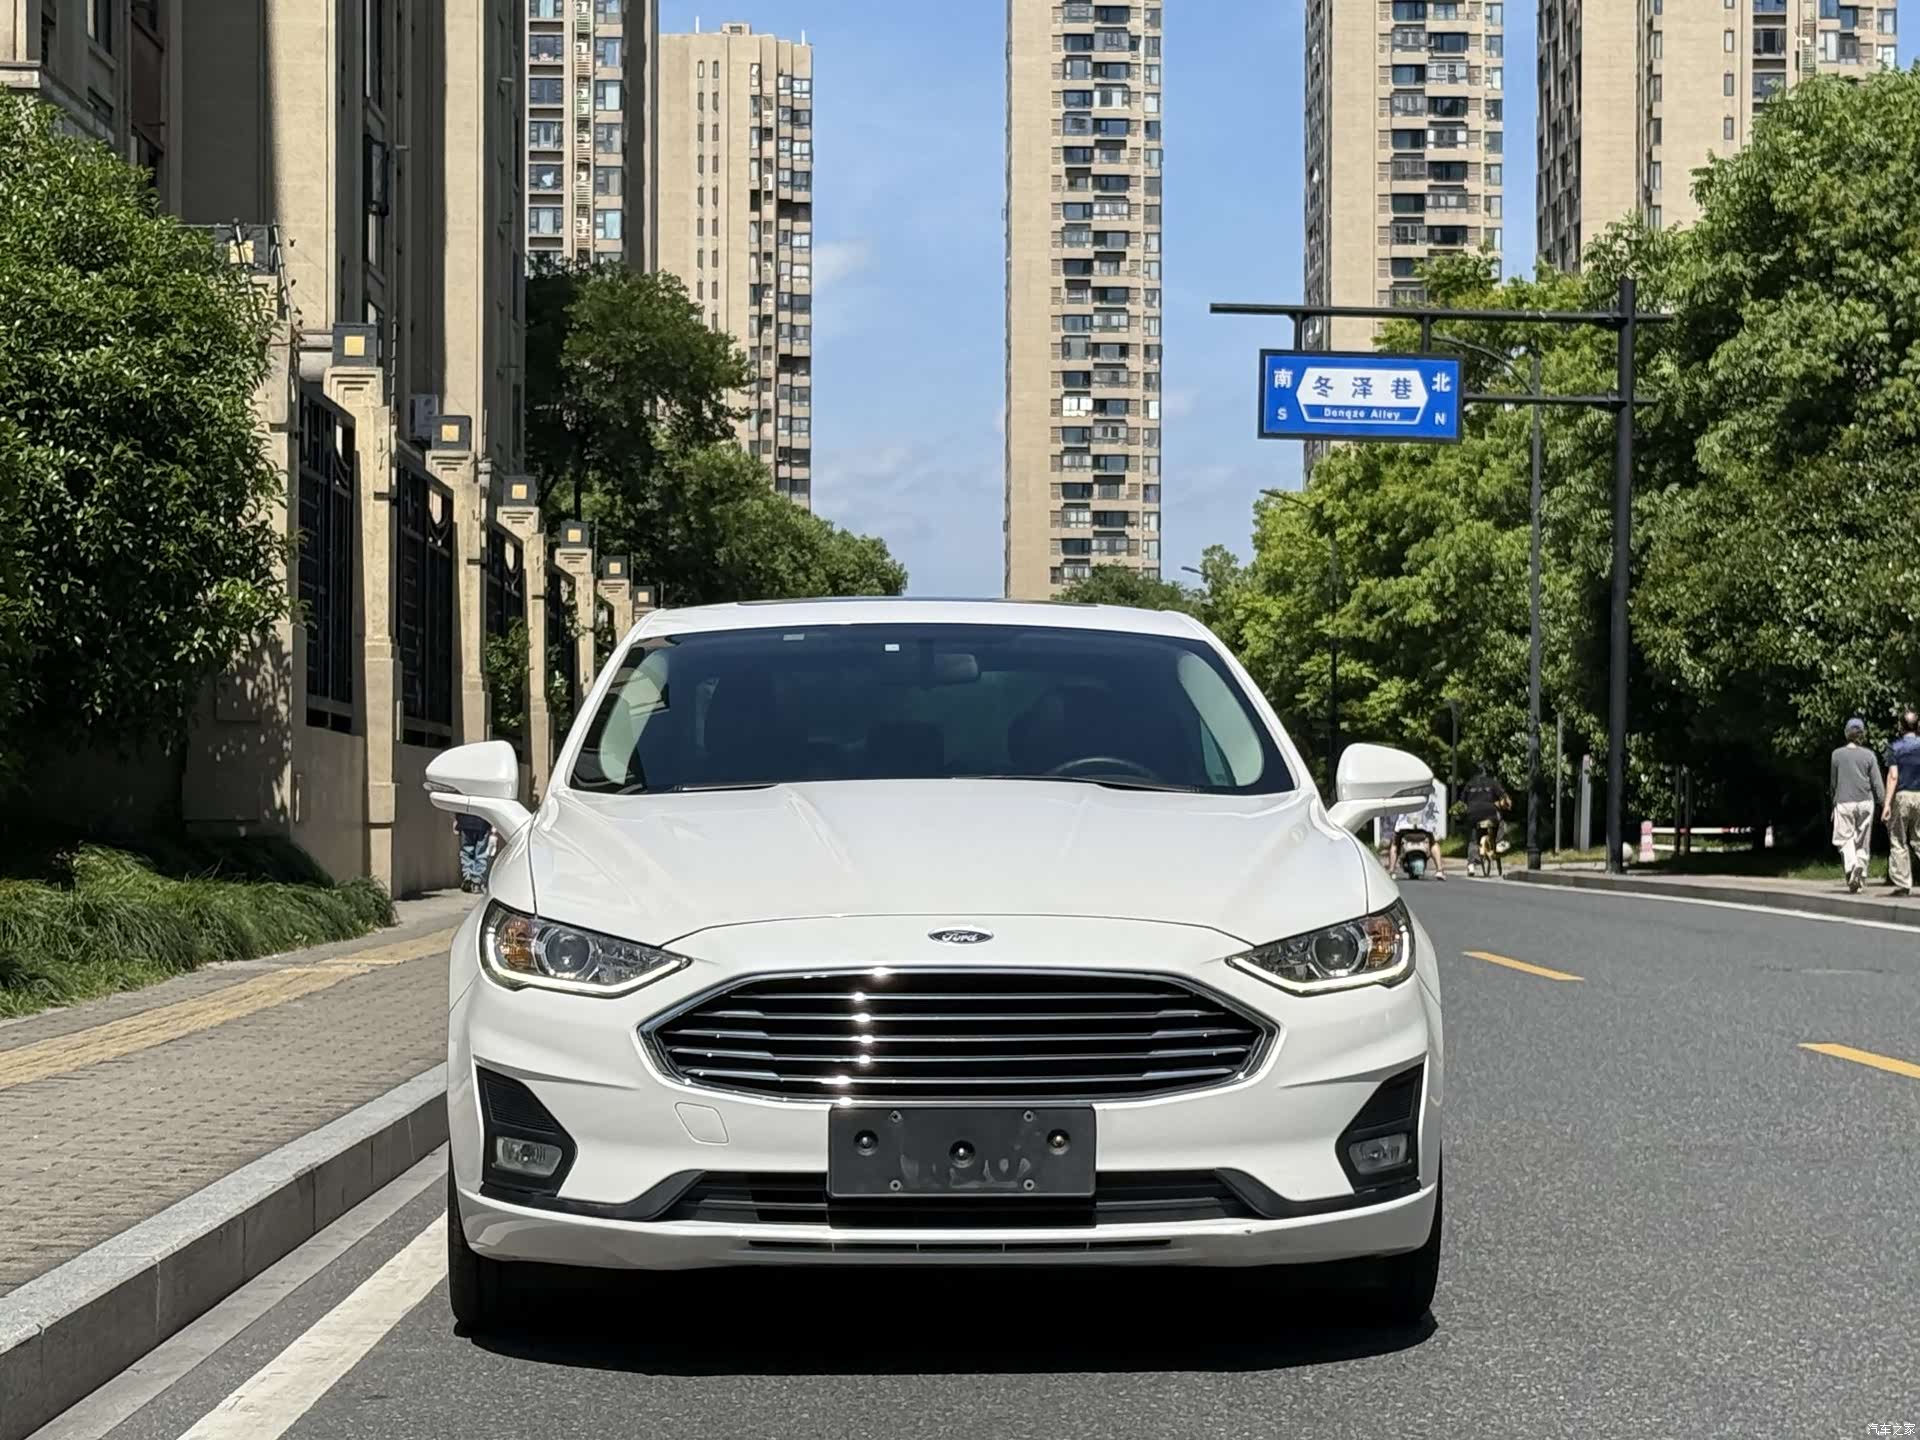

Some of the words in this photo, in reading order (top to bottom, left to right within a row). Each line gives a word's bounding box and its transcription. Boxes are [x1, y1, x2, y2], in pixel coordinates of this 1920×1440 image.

[1274, 369, 1293, 388] 南
[1432, 372, 1450, 392] 北
[1312, 376, 1412, 400] 冬泽巷
[1277, 408, 1287, 420] S
[1370, 409, 1400, 421] Alley
[1434, 413, 1446, 425] N
[942, 932, 978, 942] Ford
